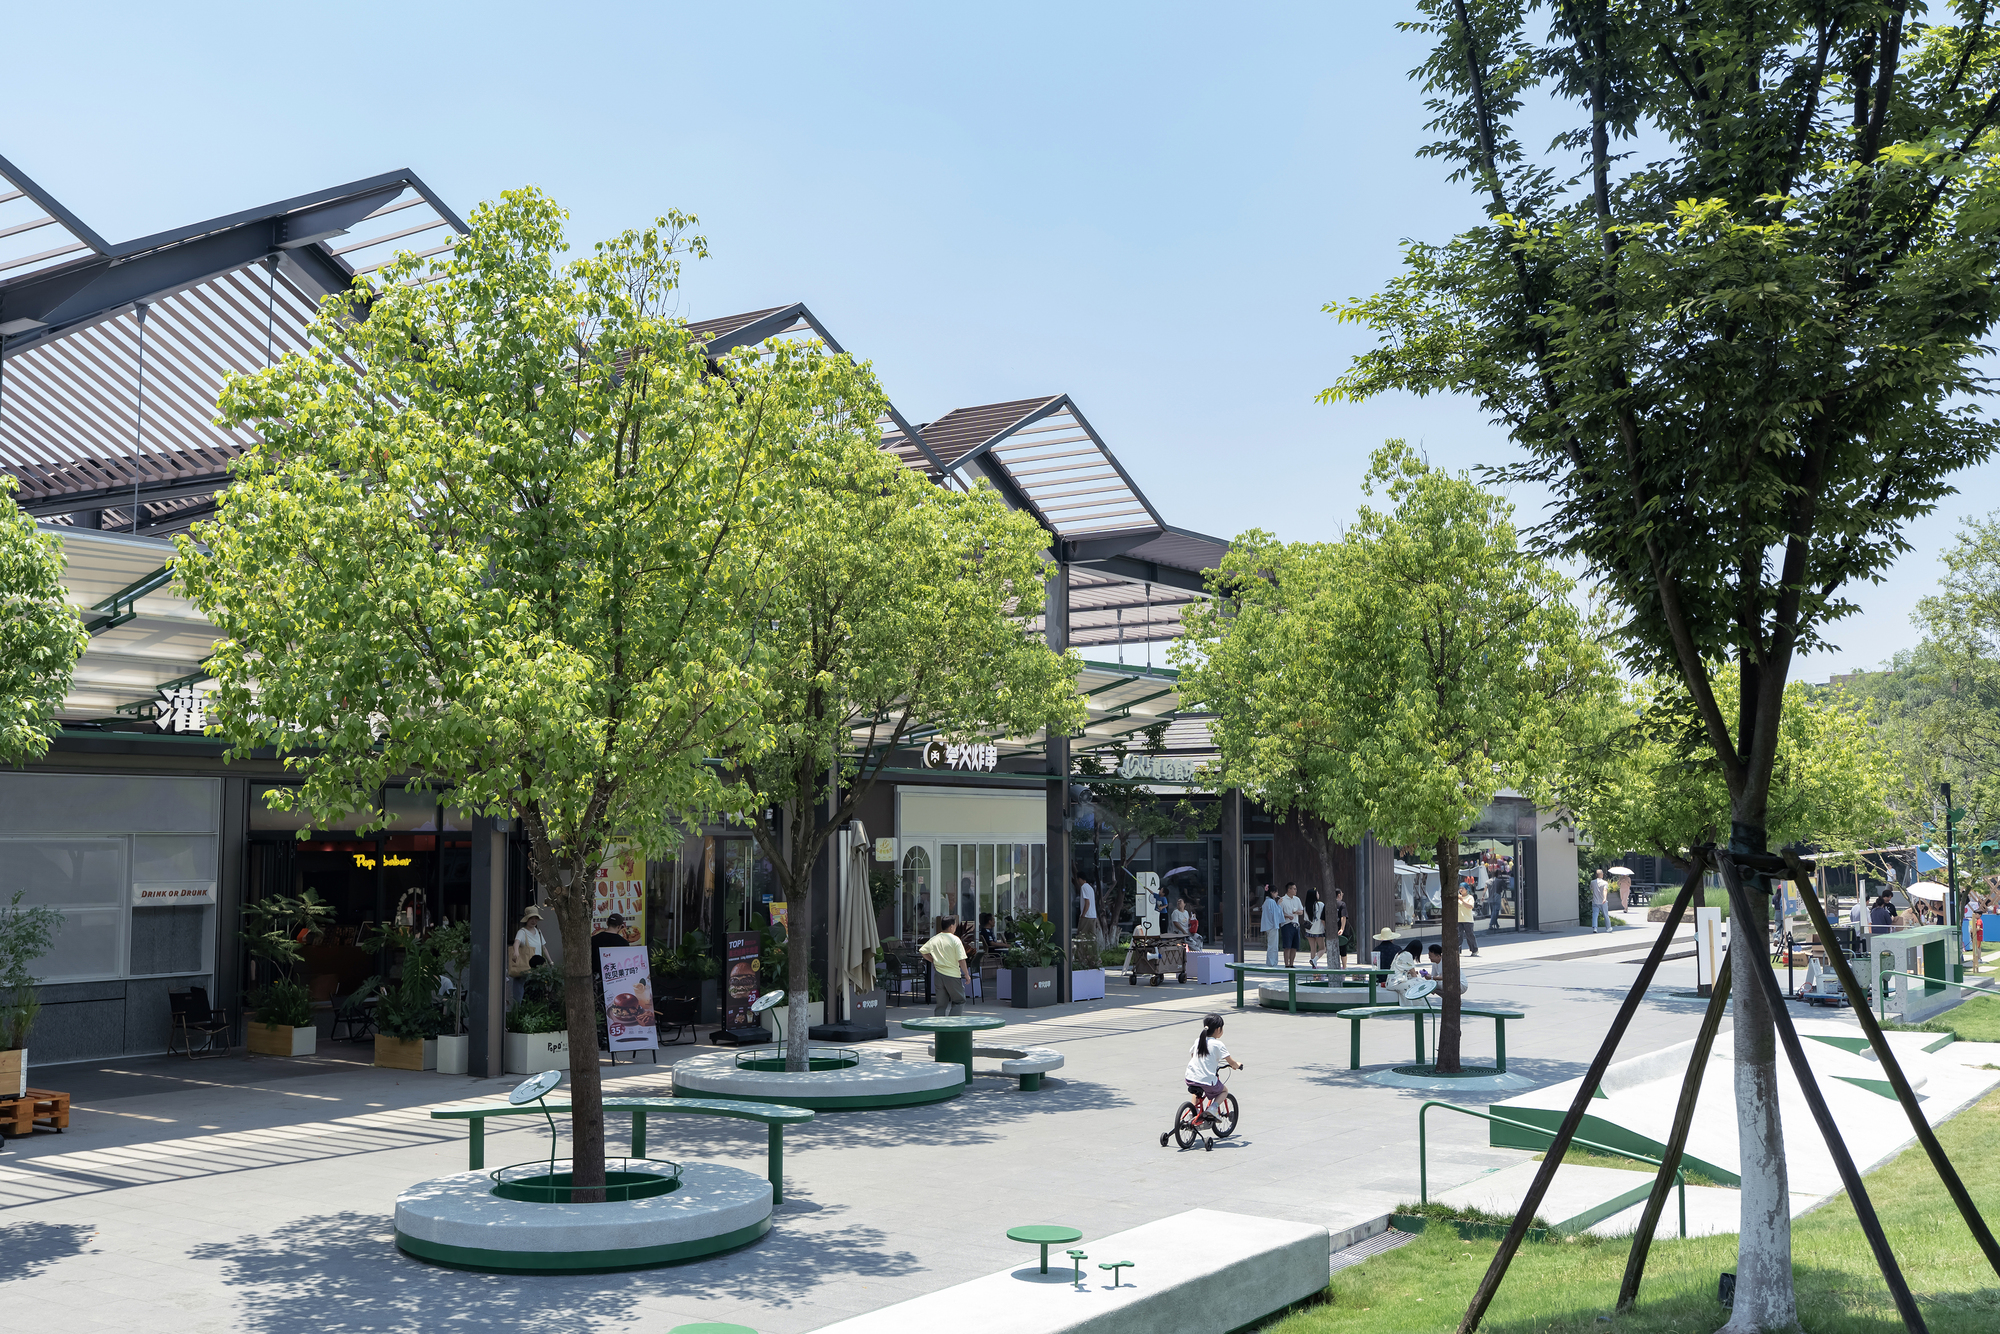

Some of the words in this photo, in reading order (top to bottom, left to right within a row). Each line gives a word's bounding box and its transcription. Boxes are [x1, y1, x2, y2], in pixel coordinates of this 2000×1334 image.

[1150, 876, 1157, 887] A
[141, 890, 168, 898] DRINK
[180, 889, 208, 897] DRUNK
[728, 939, 745, 949] TOP1
[610, 1026, 621, 1035] 35
